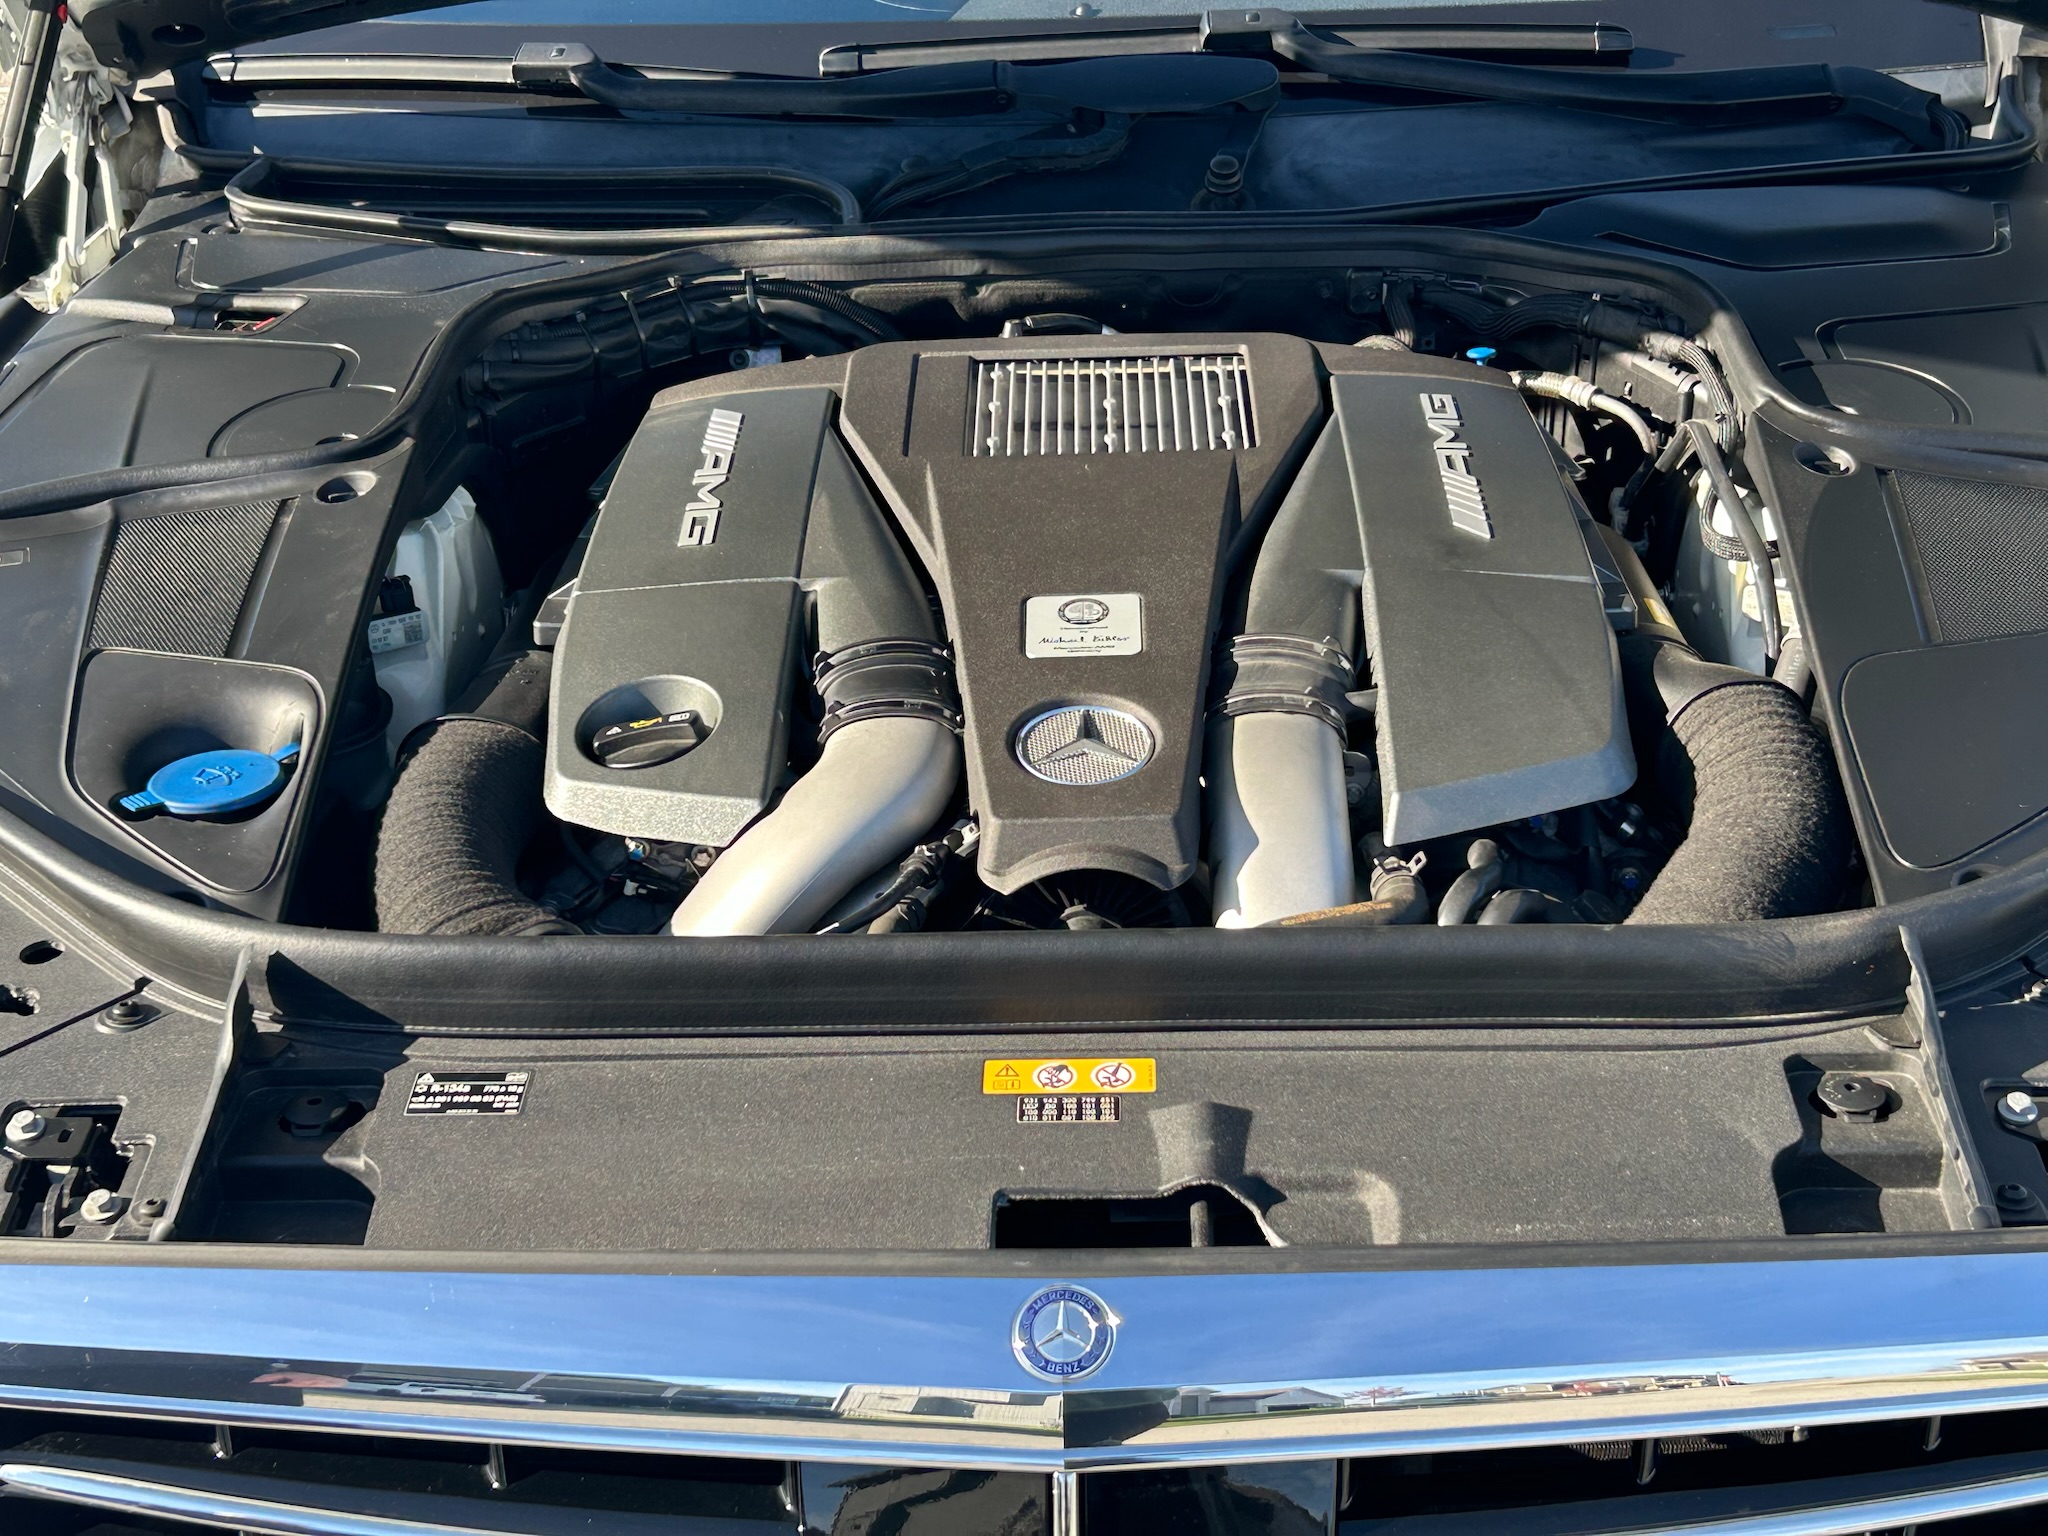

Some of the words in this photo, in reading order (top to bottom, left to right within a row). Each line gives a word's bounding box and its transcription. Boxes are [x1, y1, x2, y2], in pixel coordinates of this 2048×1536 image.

[1420, 393, 1479, 486] AMG
[677, 446, 733, 547] AMG
[1032, 1290, 1095, 1311] MERCEDES
[1047, 1363, 1081, 1373] BENZ
